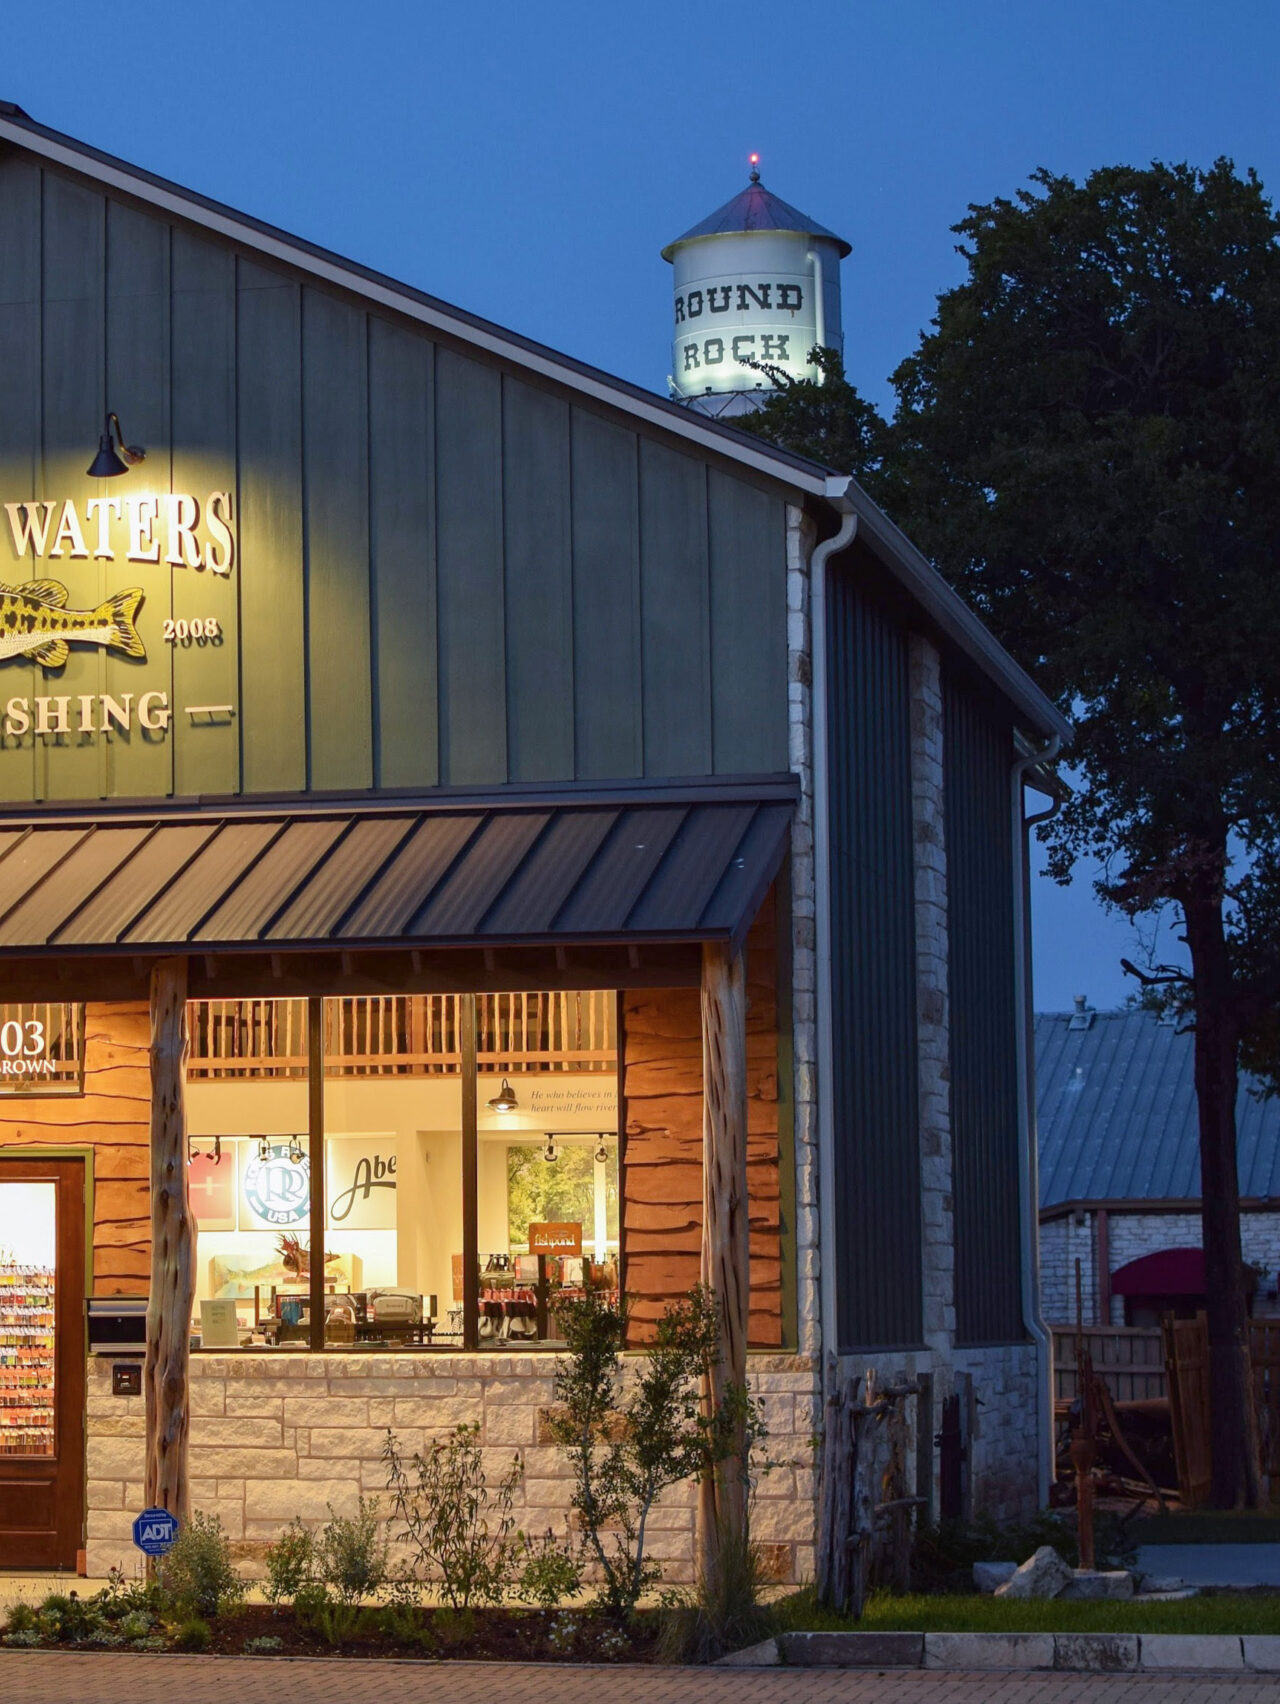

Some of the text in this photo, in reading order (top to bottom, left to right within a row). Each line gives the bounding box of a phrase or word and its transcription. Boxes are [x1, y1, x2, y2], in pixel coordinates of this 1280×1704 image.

[675, 283, 804, 324] ROUND
[684, 334, 790, 371] ROCK
[4, 491, 234, 575] WATERS
[163, 618, 219, 640] 2008
[531, 1090, 613, 1099] He who believes in
[530, 1103, 554, 1112] heart
[556, 1103, 573, 1112] will
[574, 1103, 593, 1114] flow
[267, 1210, 299, 1224] USA
[534, 1233, 576, 1249] fishpond
[142, 1523, 171, 1540] ADT
